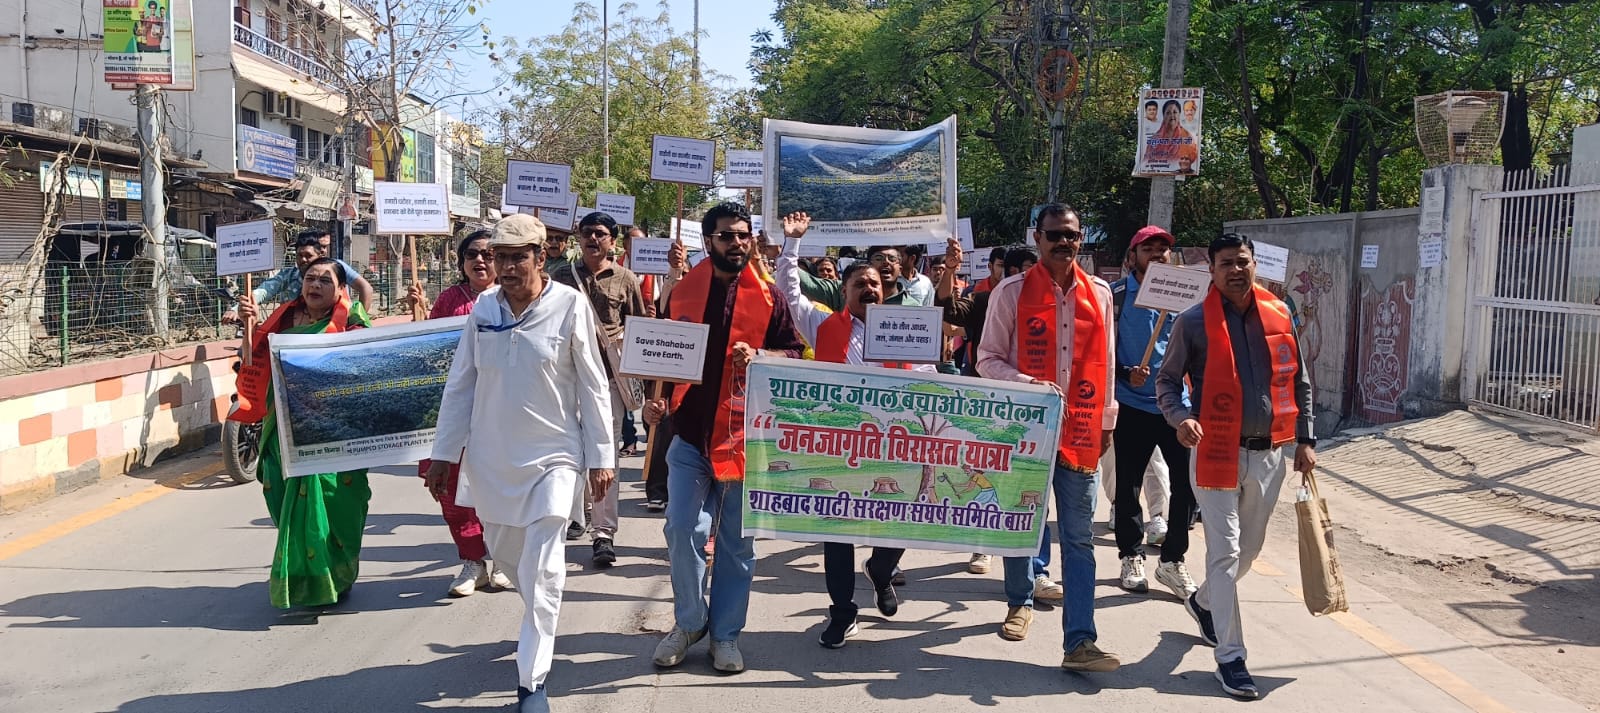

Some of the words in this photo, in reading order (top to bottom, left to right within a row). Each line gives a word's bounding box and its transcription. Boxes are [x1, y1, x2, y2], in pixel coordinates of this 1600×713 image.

[880, 321, 891, 330] जीने
[892, 321, 897, 330] के
[899, 322, 909, 330] तीन
[911, 324, 928, 332] आधार,
[636, 337, 654, 345] Save
[656, 338, 695, 350] Shahabad
[875, 335, 887, 343] जल,
[889, 334, 903, 342] जंगल
[905, 334, 915, 343] और
[642, 349, 661, 357] Save
[662, 351, 684, 360] Earth.
[315, 390, 326, 400] एक
[326, 389, 337, 397] भी
[355, 385, 365, 393] की
[396, 378, 410, 388] नहीं
[413, 376, 433, 385] कटनी
[768, 377, 844, 403] शाहबाद
[846, 379, 898, 410] जंगल
[900, 390, 966, 417] बचाओ
[968, 392, 1048, 424] आंदोलन
[298, 448, 316, 456] विकास
[378, 442, 402, 450] STORAGE
[777, 423, 885, 466] जनजागृति
[887, 426, 962, 466] विरासत
[964, 440, 1013, 472] यात्रा
[748, 490, 810, 516] शाहबाद
[813, 492, 852, 517] घाटी
[854, 490, 908, 523] संरक्षण
[910, 495, 950, 525] संघर्ष
[952, 500, 1003, 530] समिति
[1004, 503, 1034, 531] बारां
